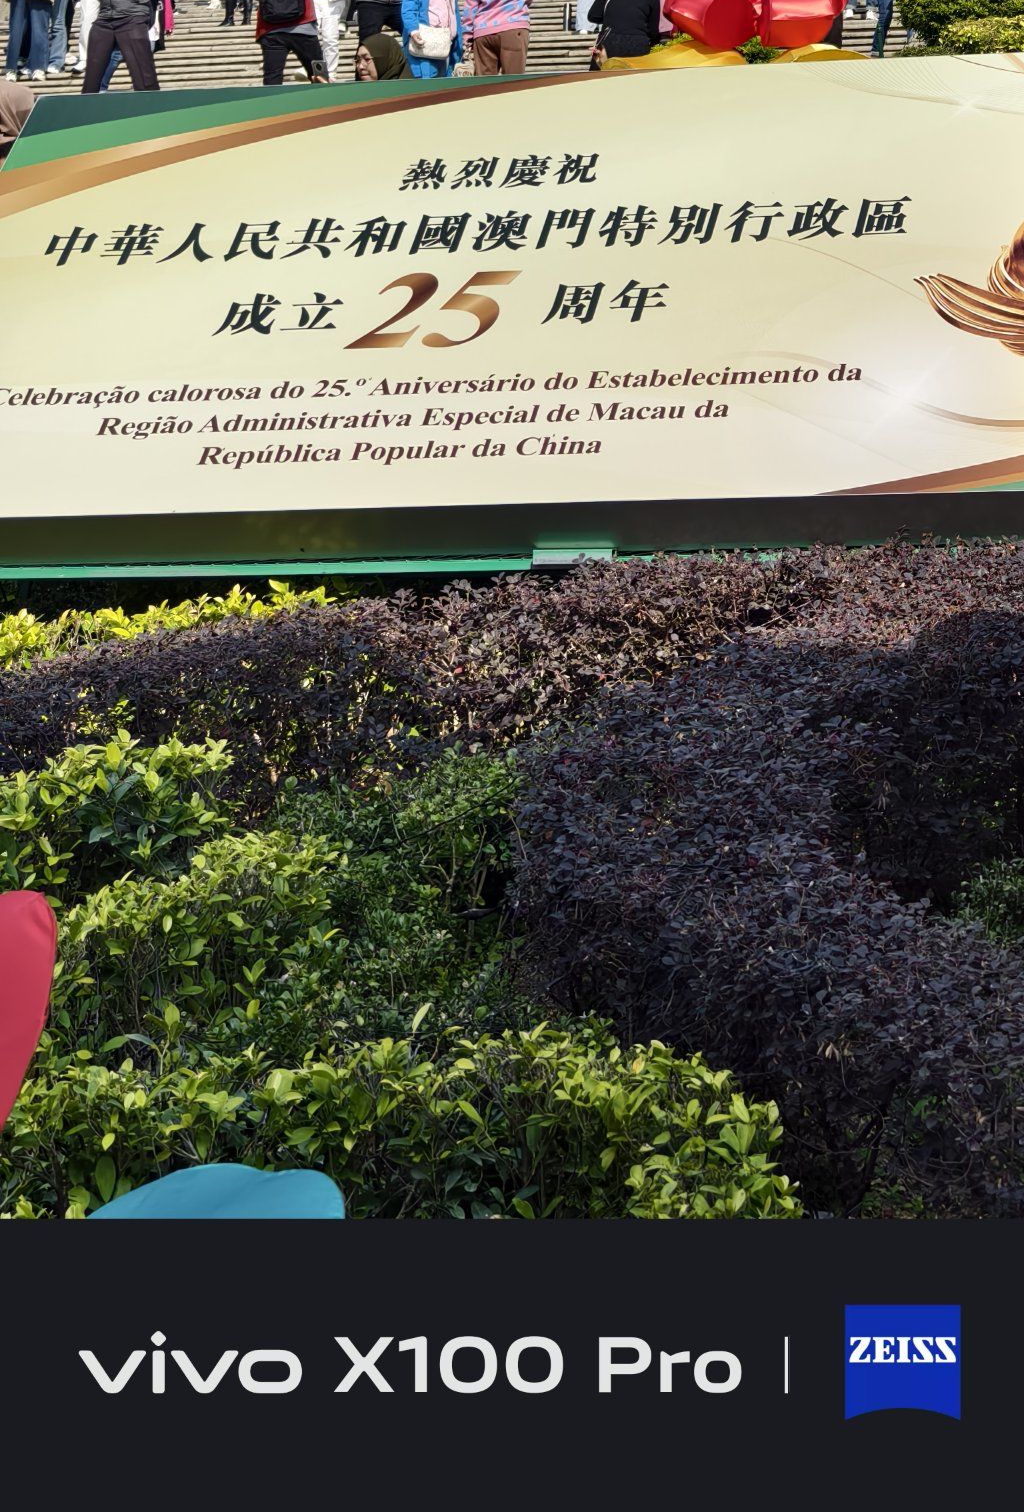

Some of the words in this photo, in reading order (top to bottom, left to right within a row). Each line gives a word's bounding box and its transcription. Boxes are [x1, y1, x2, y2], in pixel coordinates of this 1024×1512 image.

[399, 153, 600, 191] 熱烈慶祝
[45, 195, 913, 267] 中華人民共和國澳門特別行政區
[148, 384, 262, 403] calorosa
[271, 380, 305, 399] do
[369, 373, 536, 396] Aniversário
[544, 372, 579, 391] do
[588, 366, 819, 389] Estabelecimento
[828, 363, 862, 382] da
[97, 414, 193, 439] Região
[198, 409, 412, 432] Administrativa
[421, 404, 540, 431] Especial
[547, 403, 580, 423] de
[590, 402, 686, 421] Macau
[695, 399, 729, 419] da
[198, 441, 341, 470] República
[350, 440, 466, 466] Popular
[472, 438, 506, 458] da
[516, 436, 602, 456] China
